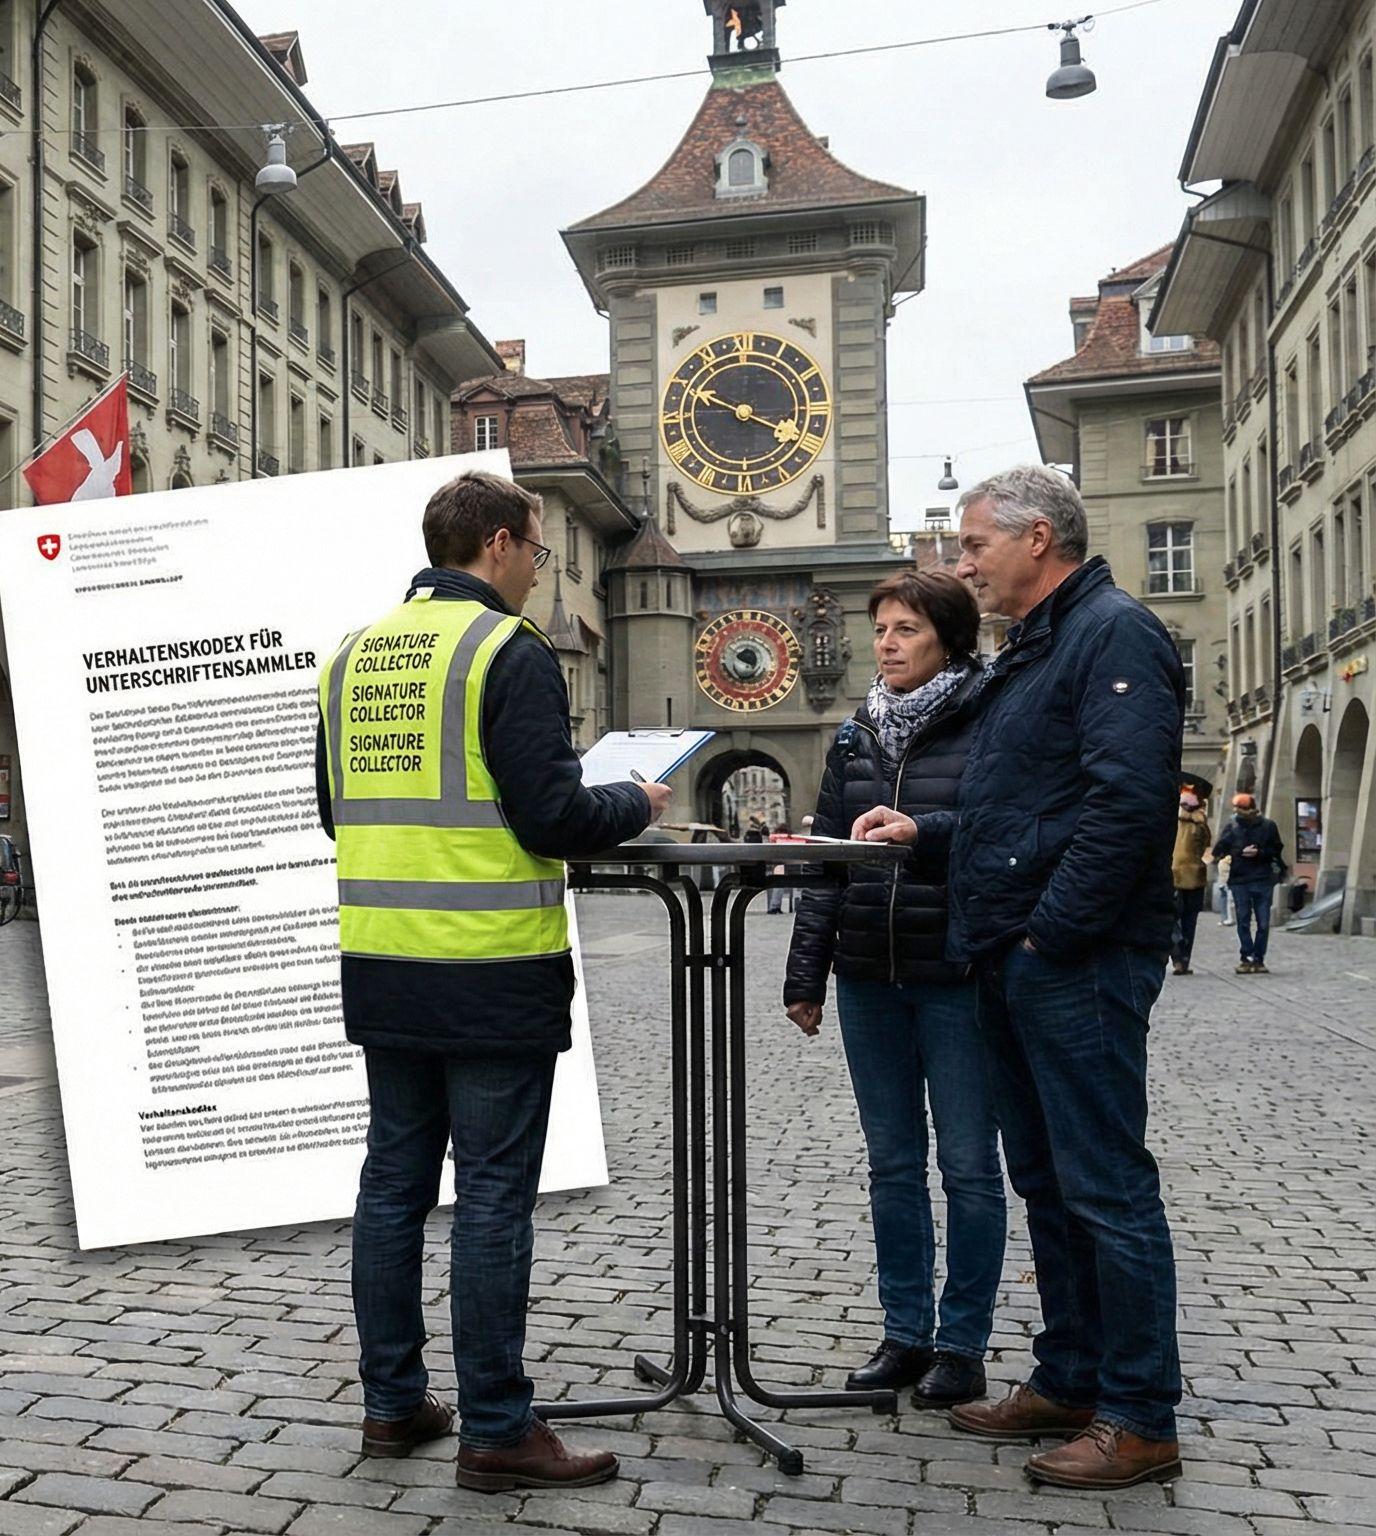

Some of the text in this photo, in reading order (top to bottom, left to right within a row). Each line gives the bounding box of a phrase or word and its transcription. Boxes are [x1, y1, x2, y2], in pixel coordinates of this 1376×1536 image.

[82, 628, 283, 670] VERHALTENSKODEX FÜR
[360, 633, 440, 653] SIGNATURE
[86, 651, 317, 694] UNTERSCHRIFTENSAMMLER
[355, 652, 432, 674] COLLECTOR
[351, 682, 427, 702] SIGNATURE
[349, 703, 426, 723] COLLECTOR
[349, 732, 425, 752] SIGNATURE
[349, 754, 422, 773] COLLECTOR
